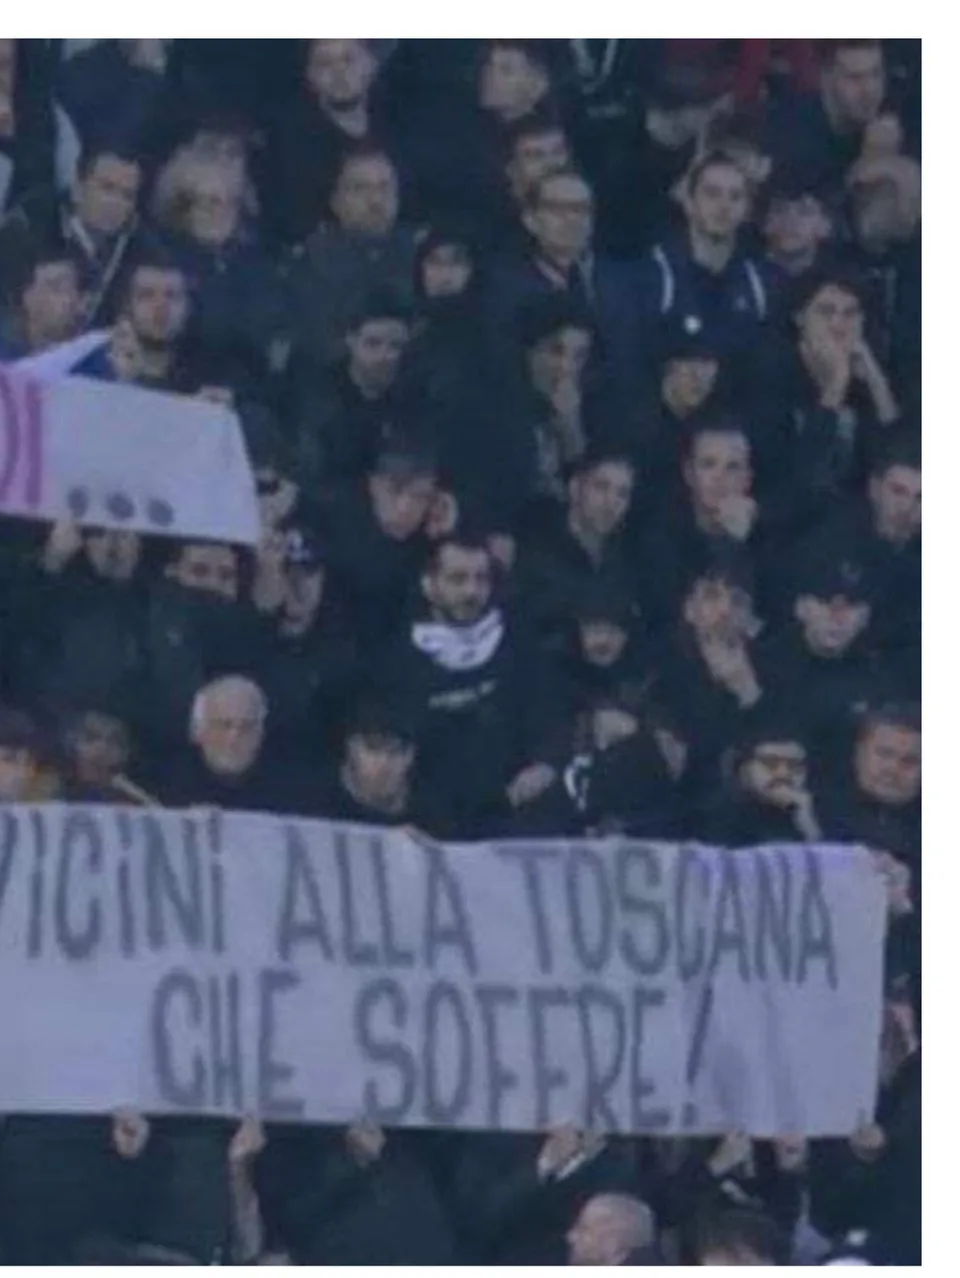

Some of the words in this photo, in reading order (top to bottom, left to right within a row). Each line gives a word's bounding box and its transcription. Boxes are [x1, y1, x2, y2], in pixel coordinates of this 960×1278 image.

[274, 822, 477, 978] ALLA
[492, 845, 840, 990] TOSCANA
[148, 966, 306, 1116] CHE
[350, 978, 714, 1132] SOFFRE!
